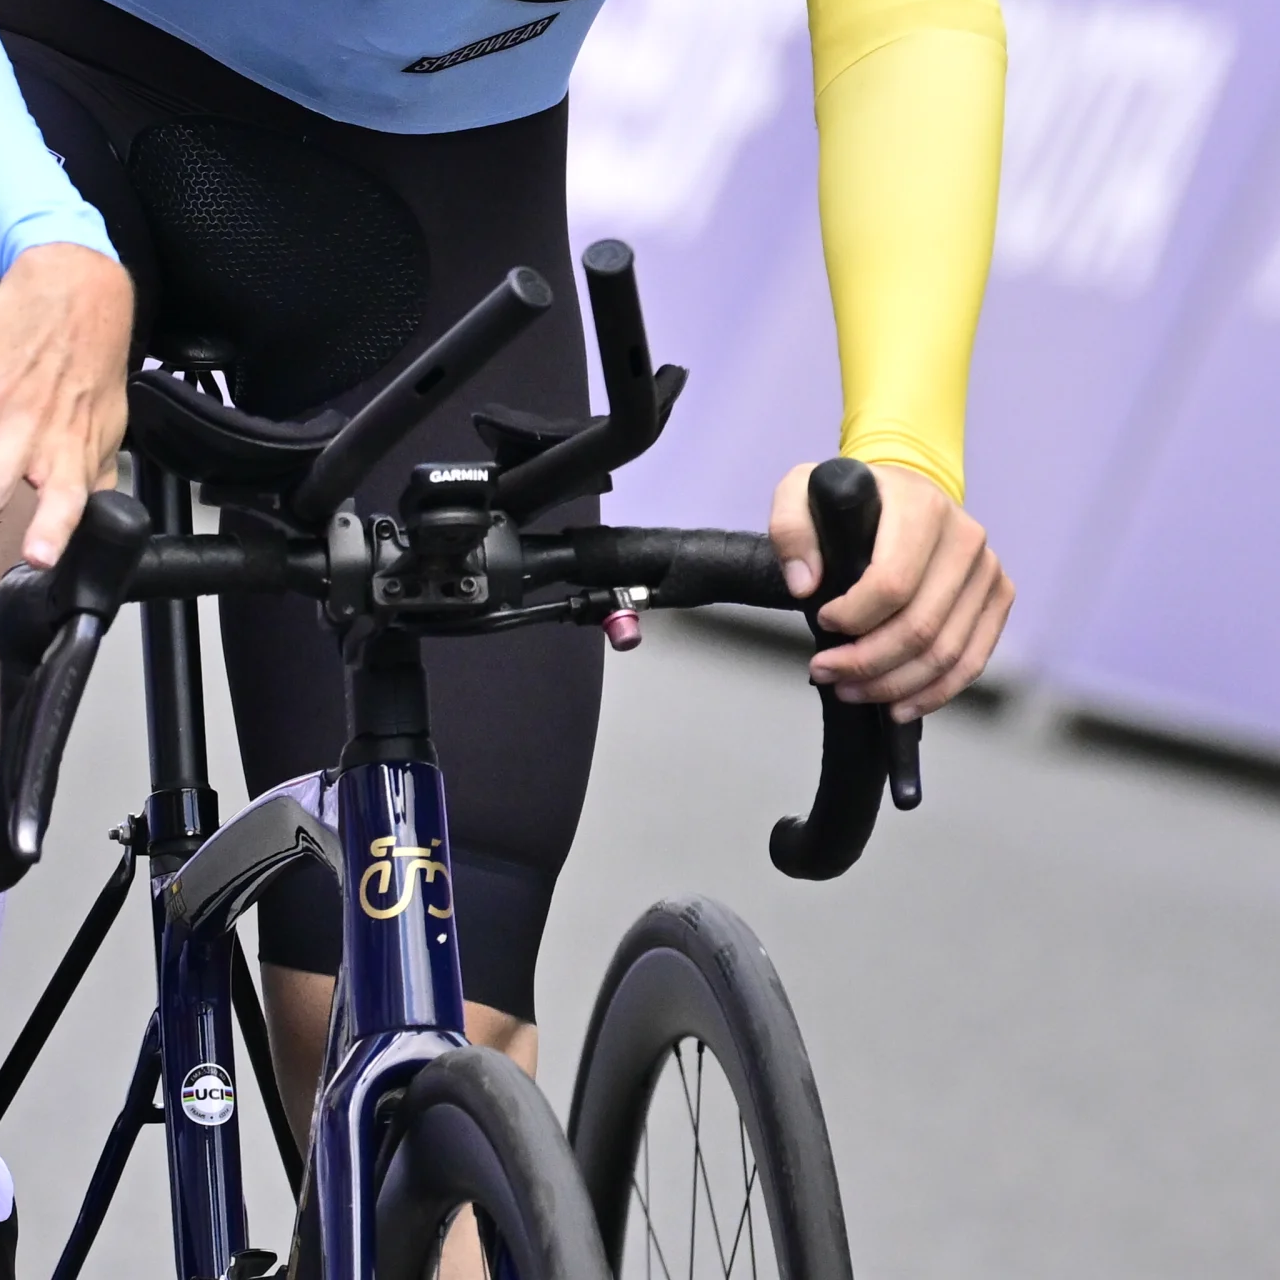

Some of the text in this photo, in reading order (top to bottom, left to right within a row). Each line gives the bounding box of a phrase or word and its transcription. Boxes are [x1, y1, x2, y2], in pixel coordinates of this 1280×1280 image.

[414, 19, 549, 71] SPEEDWEAR
[429, 468, 489, 483] GARMIN
[195, 1088, 225, 1101] UCI
